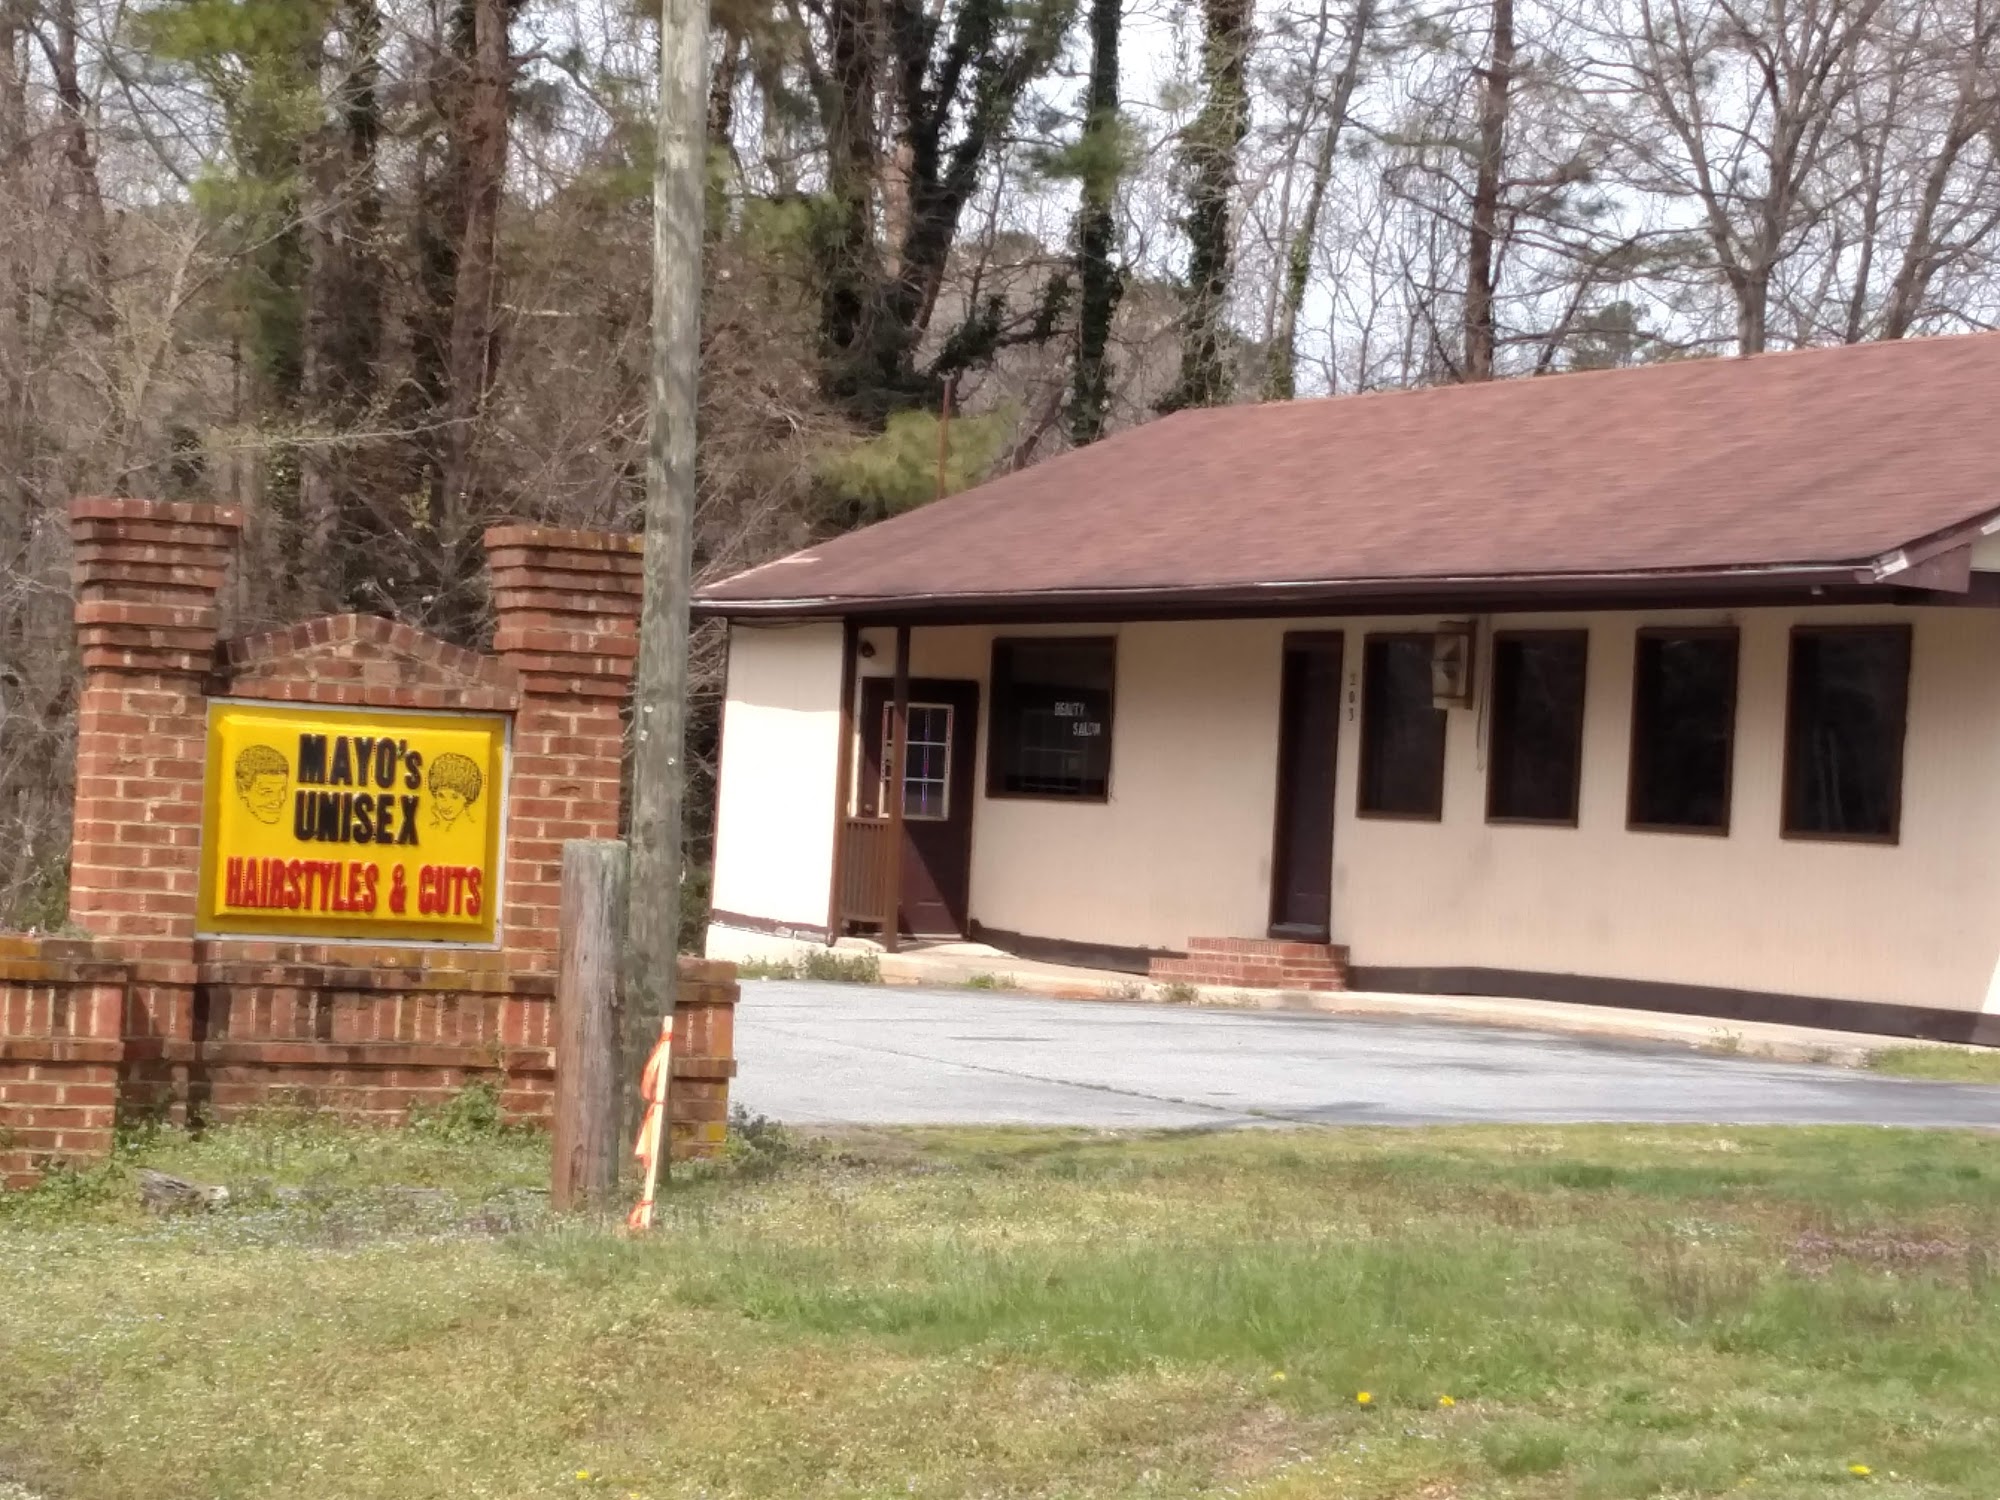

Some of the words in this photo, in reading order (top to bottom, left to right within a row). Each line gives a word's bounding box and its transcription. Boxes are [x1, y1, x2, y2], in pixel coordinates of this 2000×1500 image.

[1054, 702, 1086, 716] BEAUTY
[1072, 722, 1101, 736] SALON
[294, 789, 419, 845] UNISEX
[225, 856, 379, 913] HAIRSTYLES
[389, 863, 407, 913] &
[418, 864, 482, 916] CUTS
